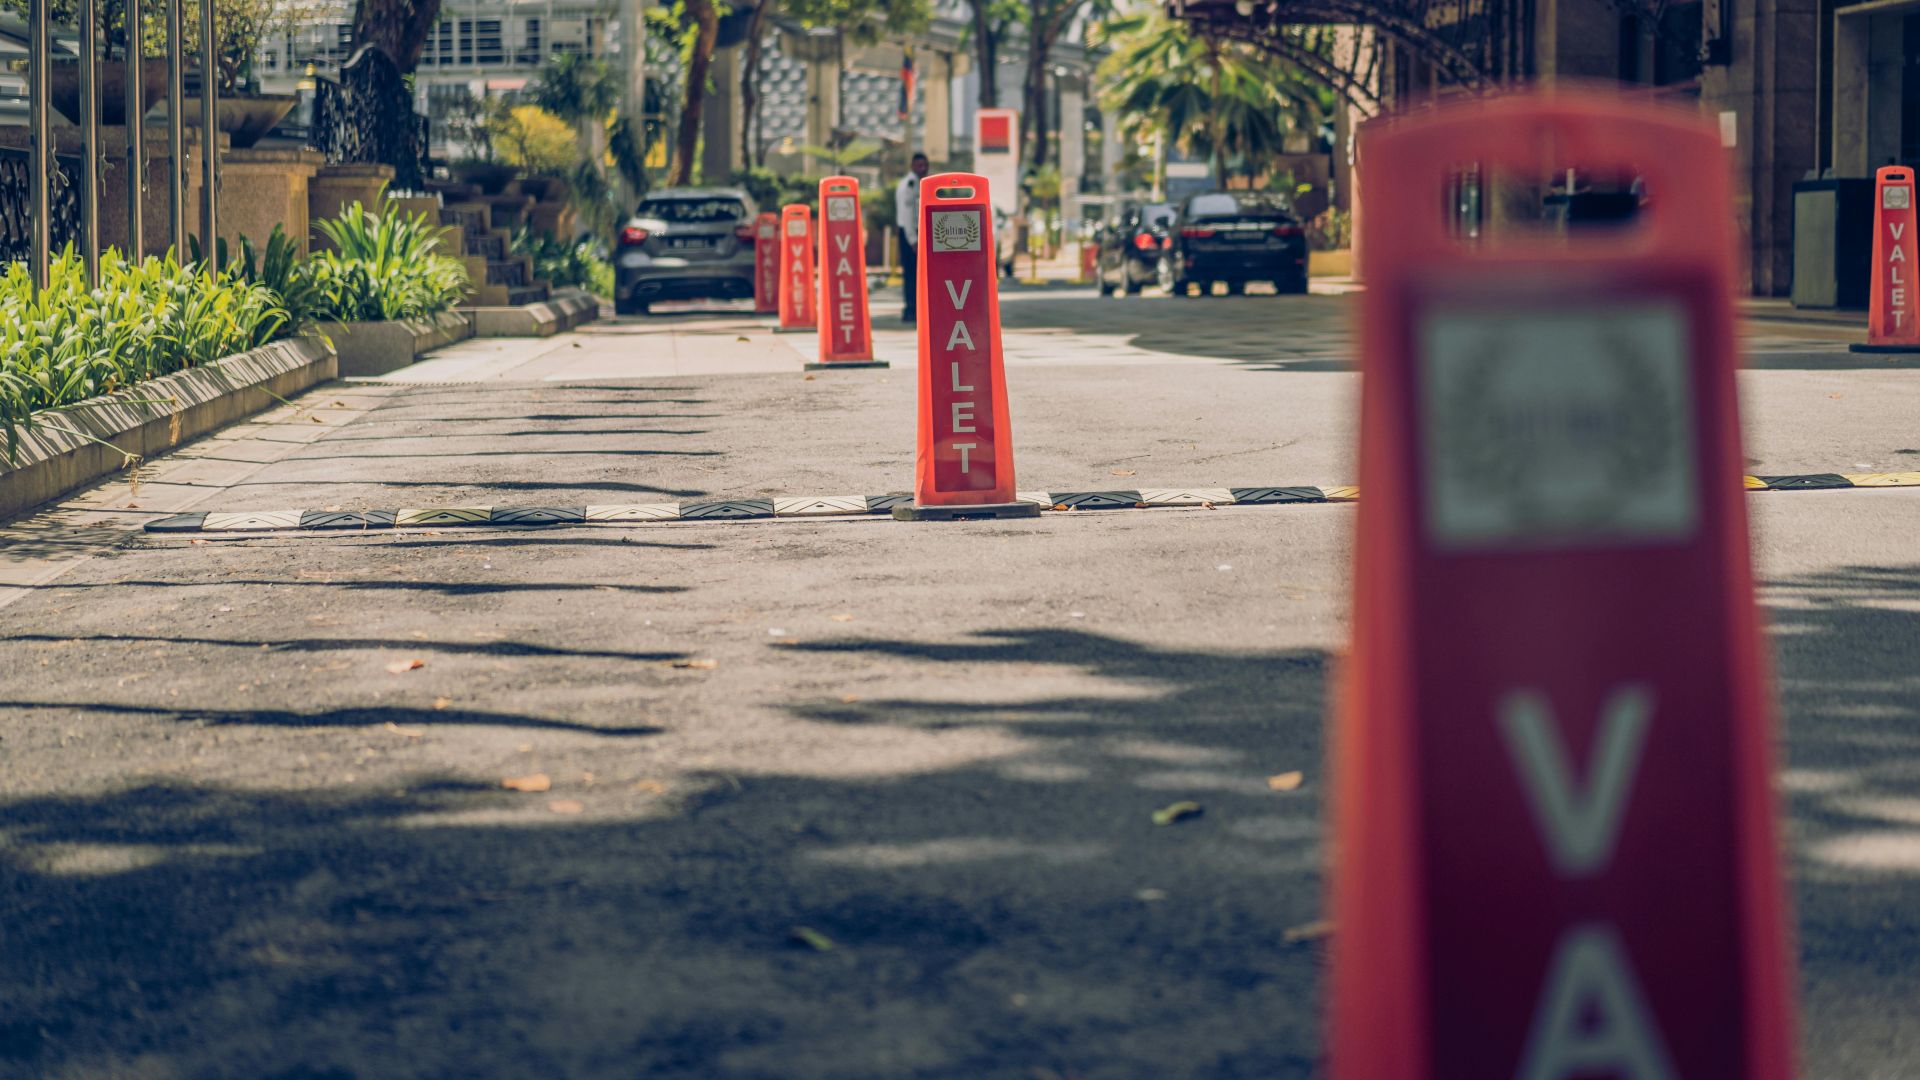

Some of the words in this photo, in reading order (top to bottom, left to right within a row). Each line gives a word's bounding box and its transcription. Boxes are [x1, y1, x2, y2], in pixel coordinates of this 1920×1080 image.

[762, 243, 773, 304] VALET
[791, 244, 804, 318] VALET
[835, 234, 854, 344] VALET
[1889, 223, 1905, 328] VALET
[944, 279, 976, 474] VALET
